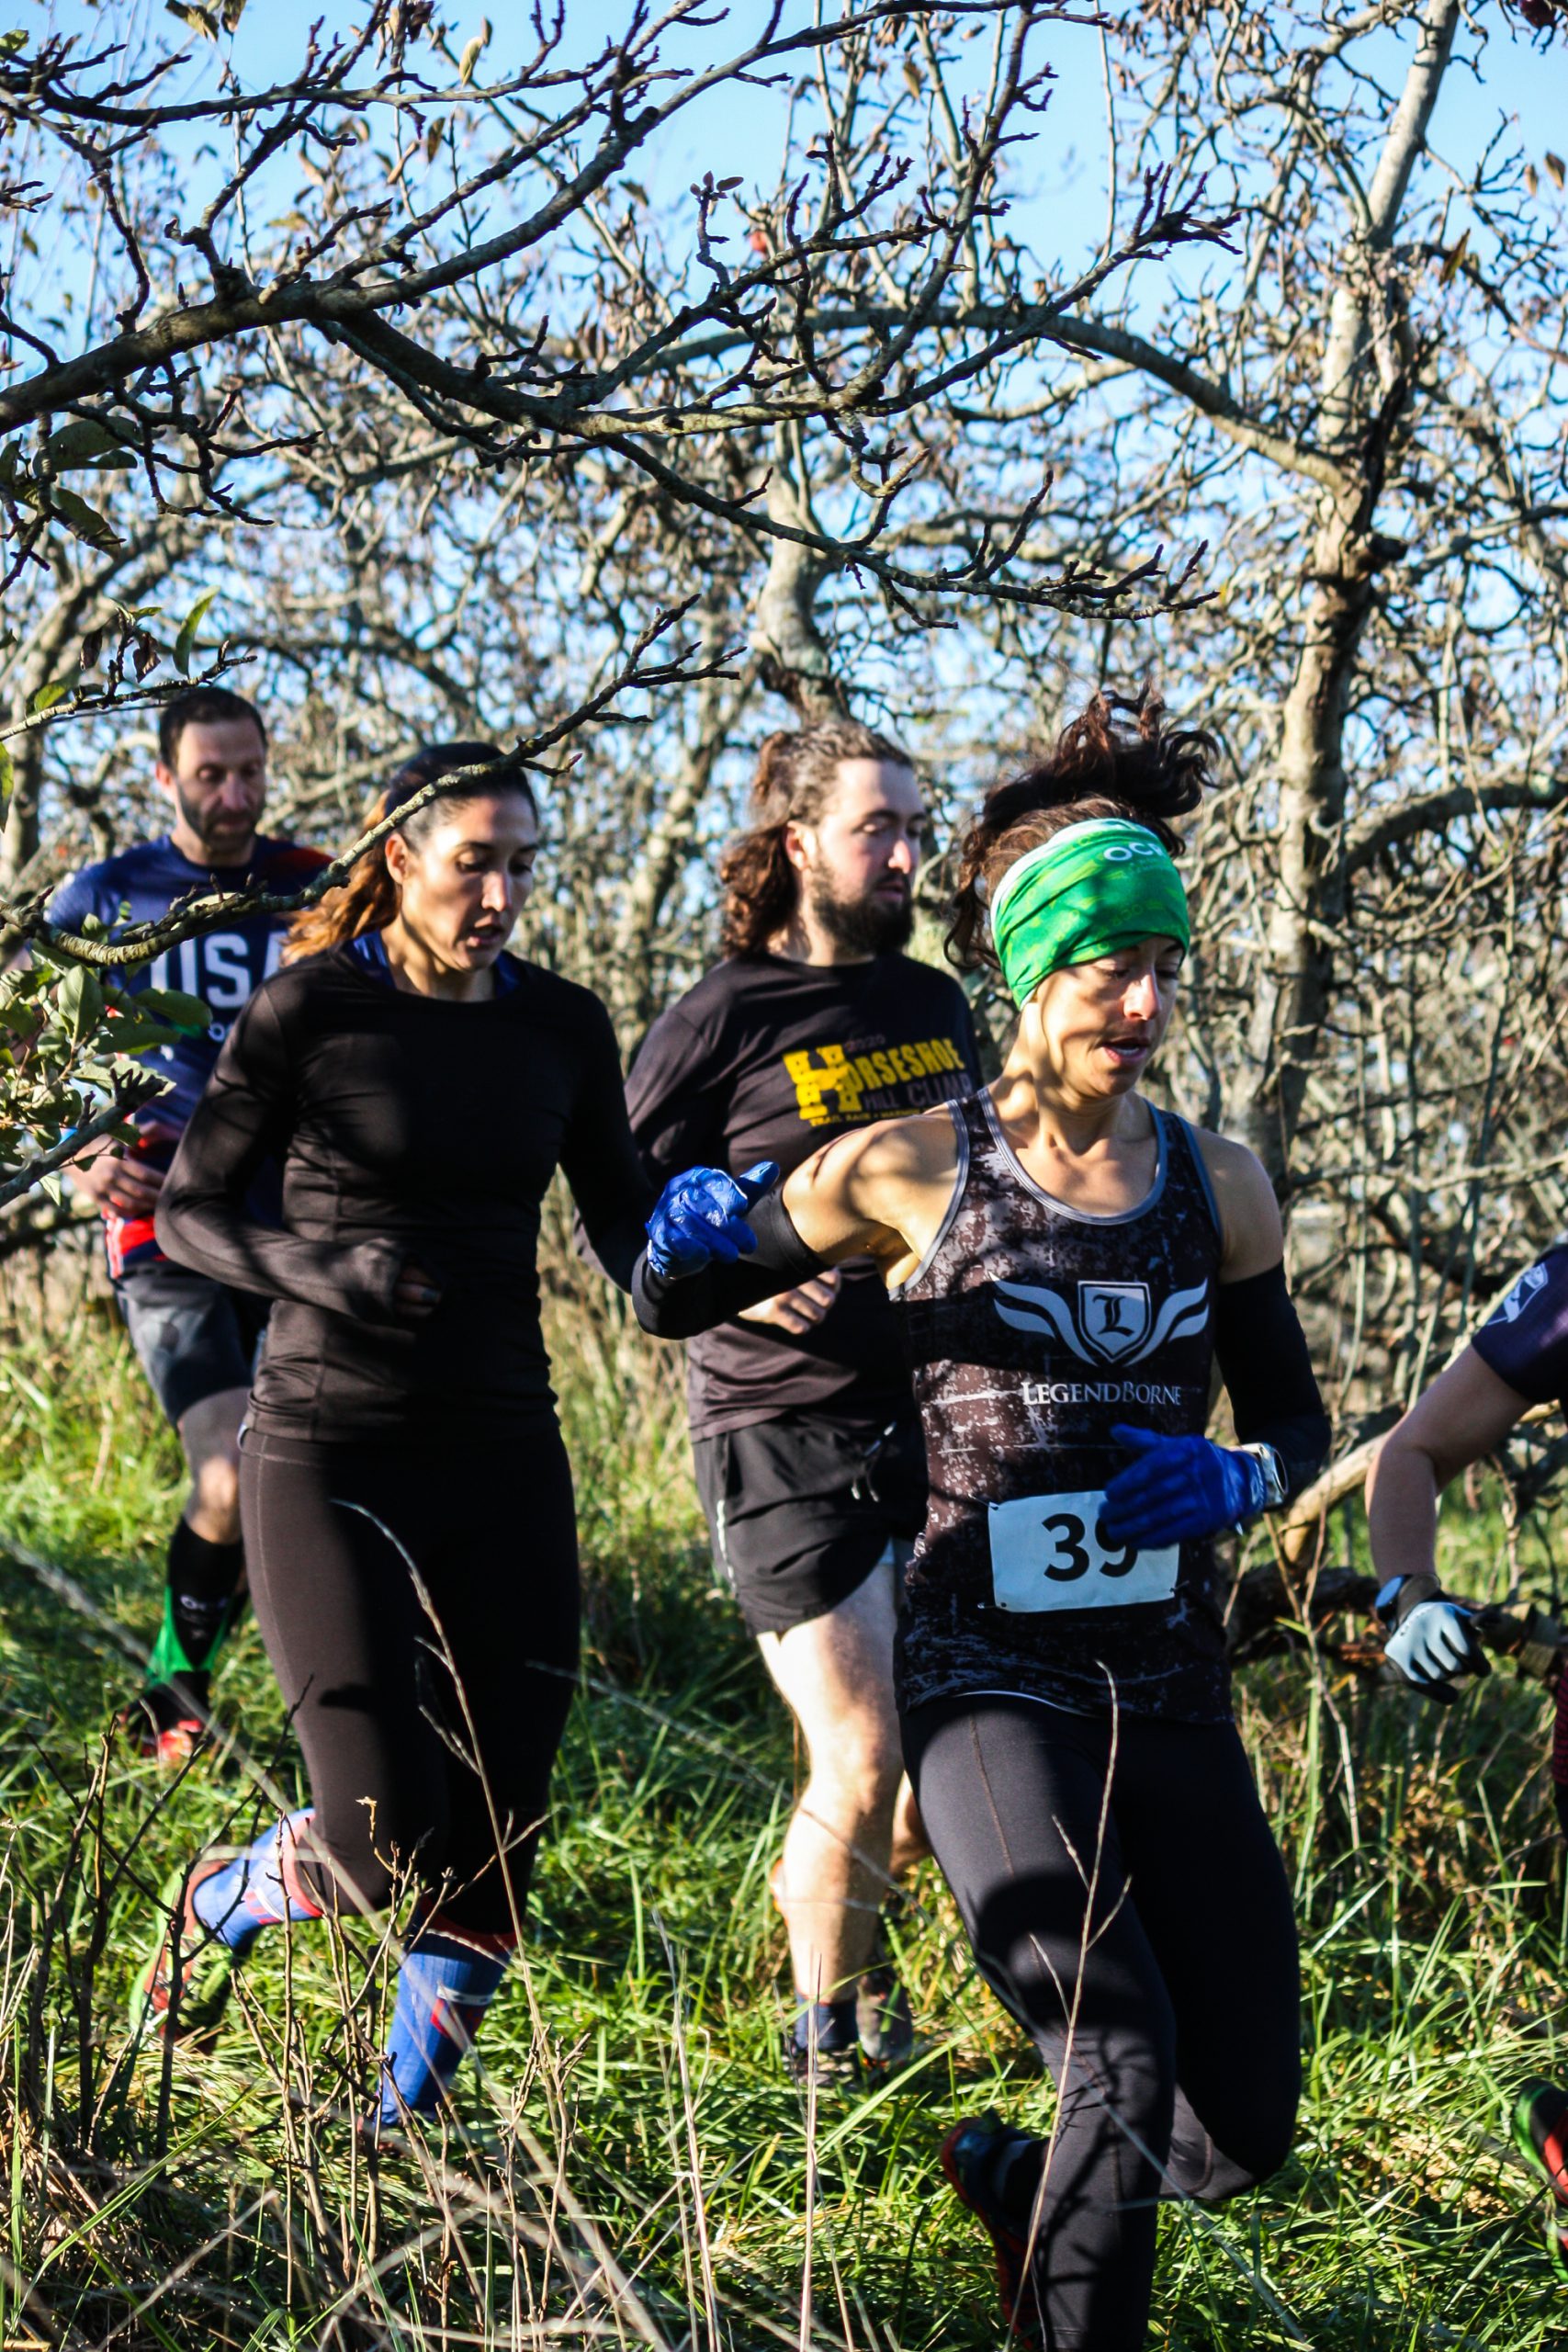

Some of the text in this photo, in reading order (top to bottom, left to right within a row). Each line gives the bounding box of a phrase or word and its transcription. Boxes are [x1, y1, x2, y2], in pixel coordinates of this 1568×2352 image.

[863, 1091, 898, 1112] HILL
[1021, 1381, 1182, 1406] LEGENDBORNE
[1042, 1512, 1139, 1582] 39
